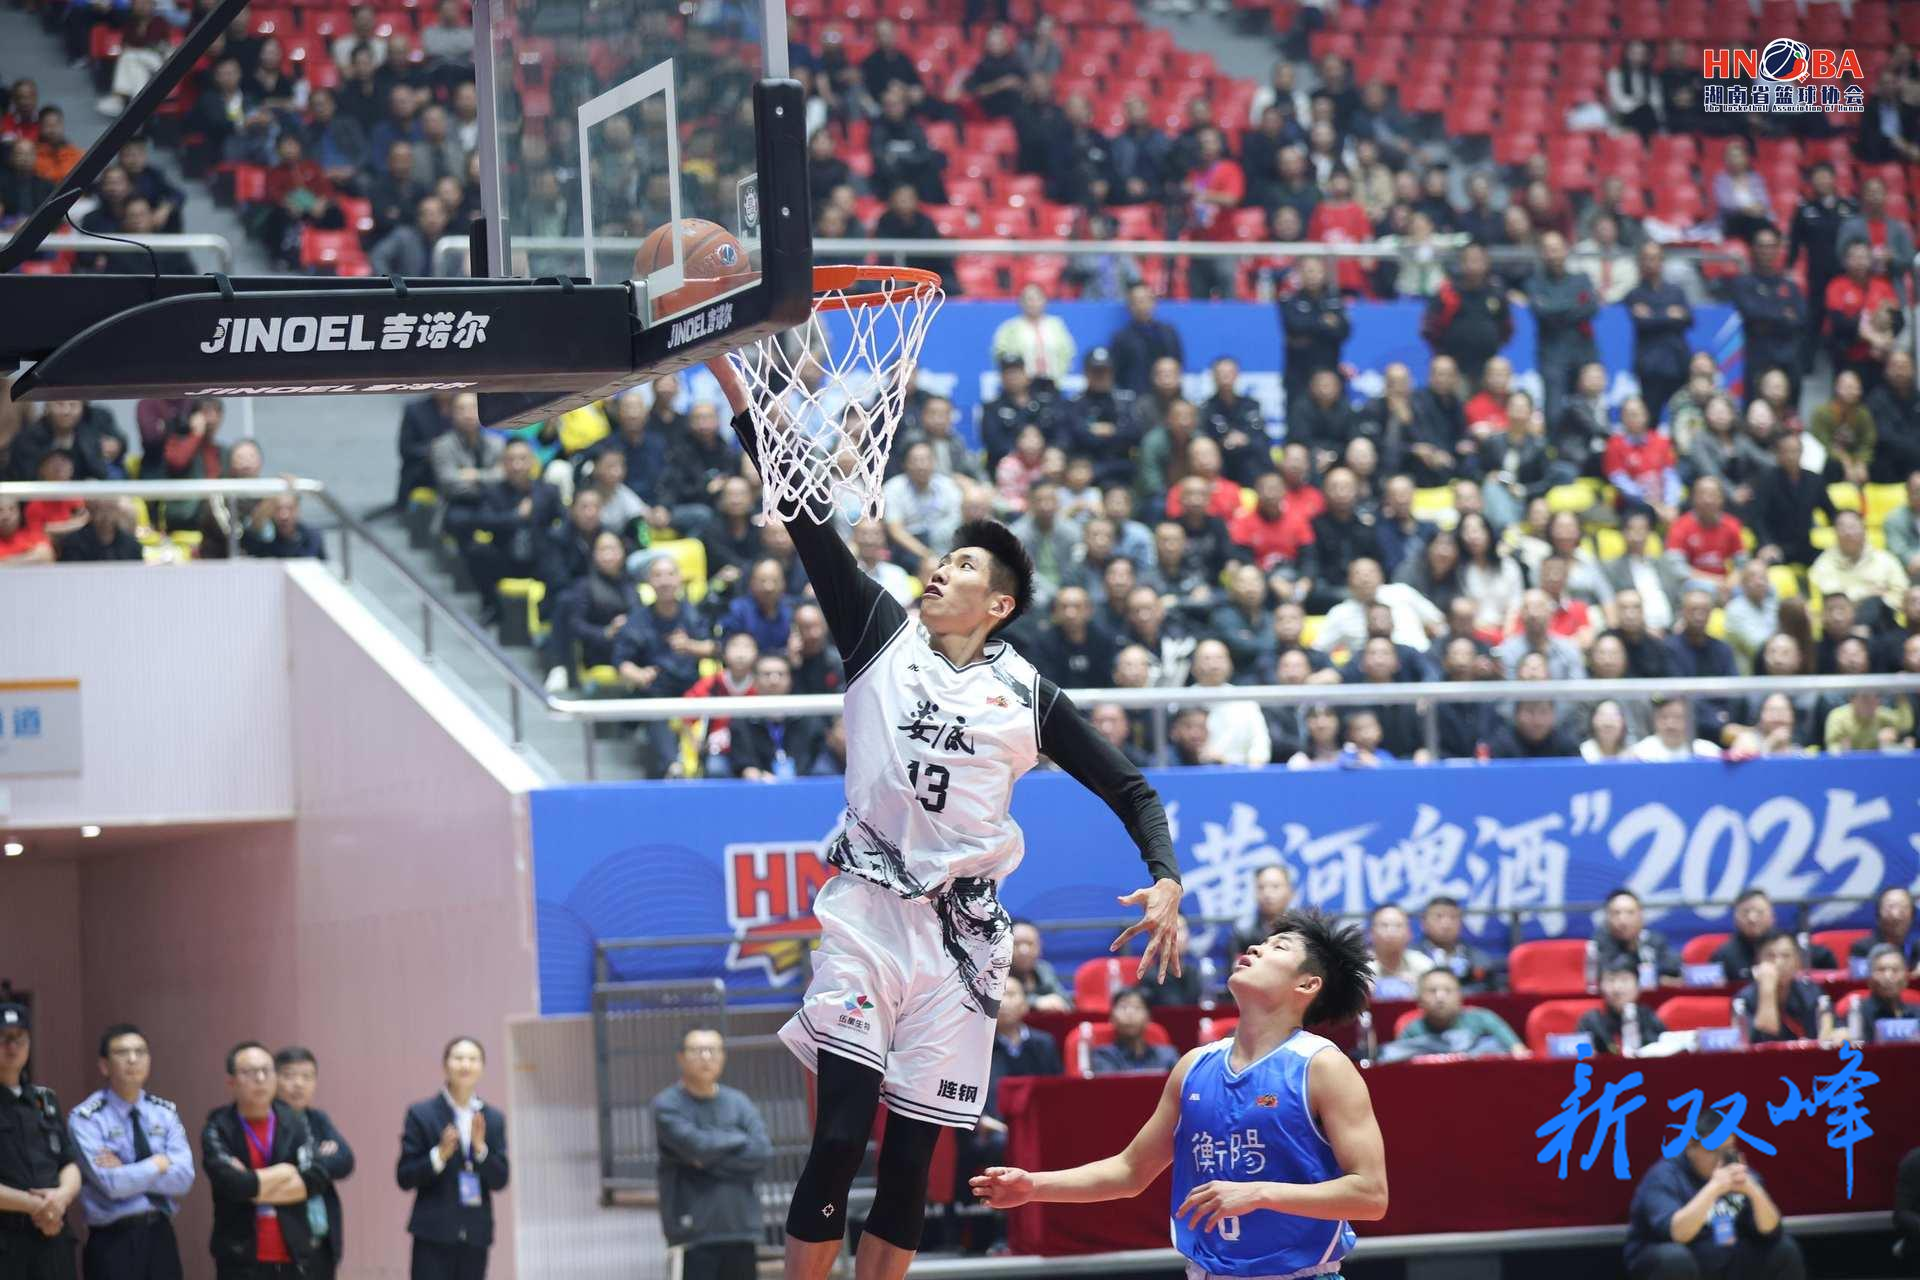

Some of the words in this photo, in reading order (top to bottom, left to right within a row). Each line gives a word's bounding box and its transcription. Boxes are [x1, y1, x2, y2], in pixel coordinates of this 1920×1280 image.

[200, 314, 375, 354] JINOEL
[381, 310, 490, 350] 吉诺尔
[667, 312, 708, 349] JINOEL
[898, 700, 975, 755] 娄底
[906, 760, 950, 814] 13
[936, 1078, 979, 1104] 涟钢
